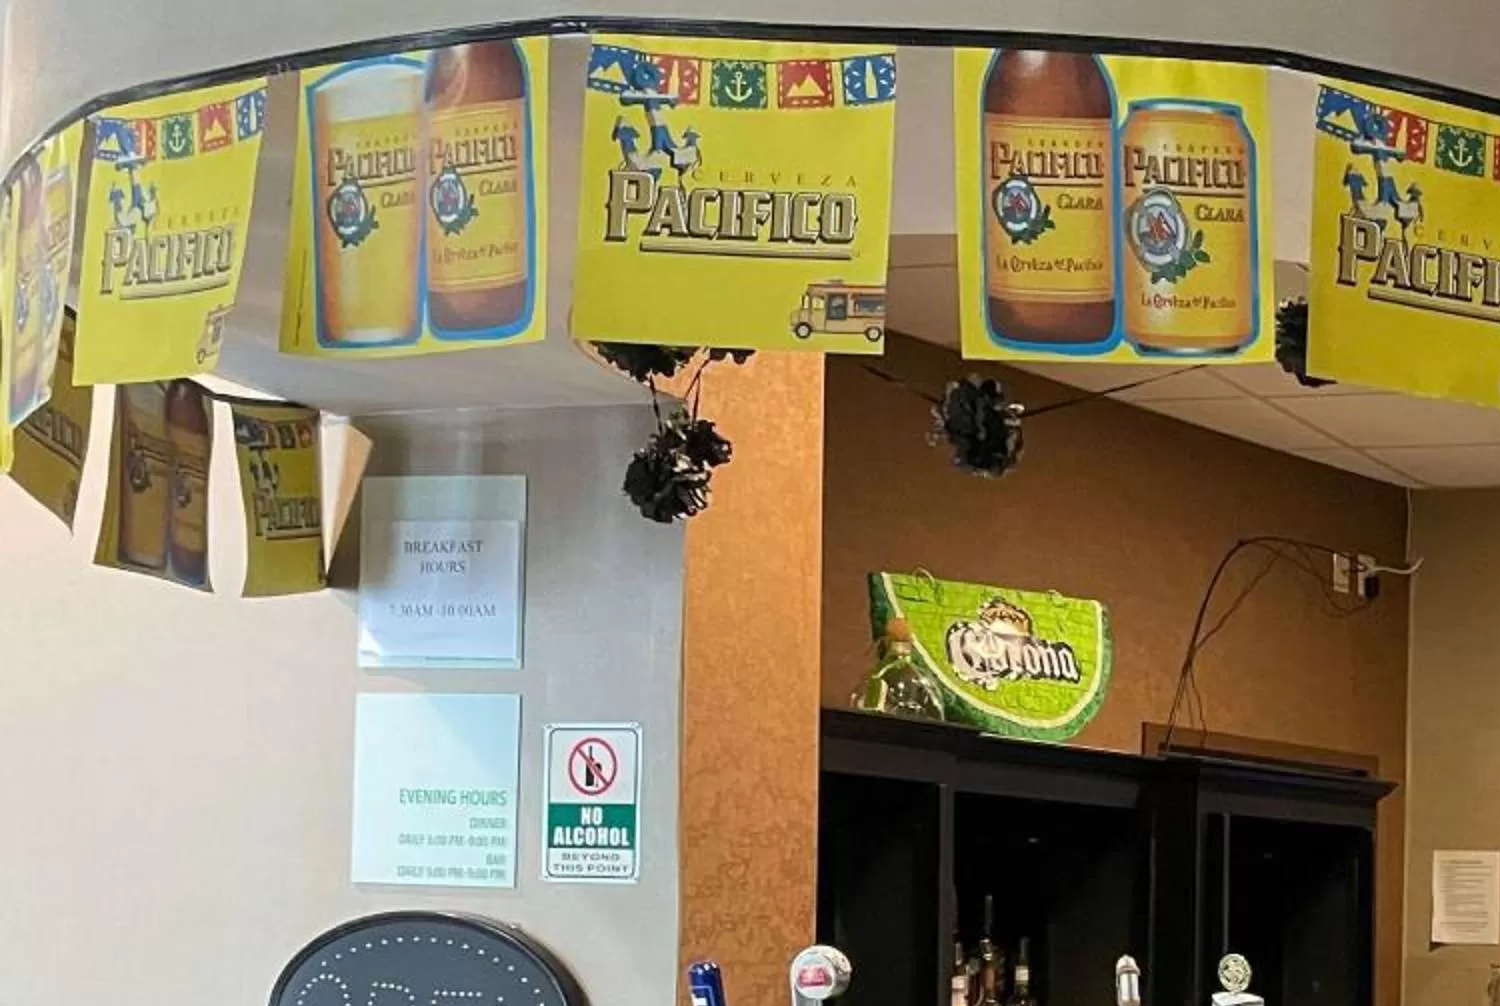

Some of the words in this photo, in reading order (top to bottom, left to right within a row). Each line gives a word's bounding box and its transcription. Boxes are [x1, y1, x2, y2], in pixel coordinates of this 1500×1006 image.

[990, 140, 1105, 179] PACIFICO
[1123, 145, 1246, 189] PACIFICO
[691, 170, 857, 187] CERVEZA
[604, 169, 859, 245] PACIFICO
[1056, 193, 1104, 210] CLARA
[1194, 203, 1245, 222] CLARA
[100, 226, 235, 295] PACIFICO
[404, 540, 484, 553] BREAKFAST
[420, 560, 465, 574] HOURS
[946, 621, 1081, 691] Corona
[399, 788, 457, 805] EVENING
[459, 789, 509, 806] HOURS
[580, 806, 604, 825] NO
[553, 826, 631, 846] ALCOHOL
[562, 852, 621, 861] BEYOND
[553, 863, 584, 873] THIS
[587, 863, 628, 873] POINT
